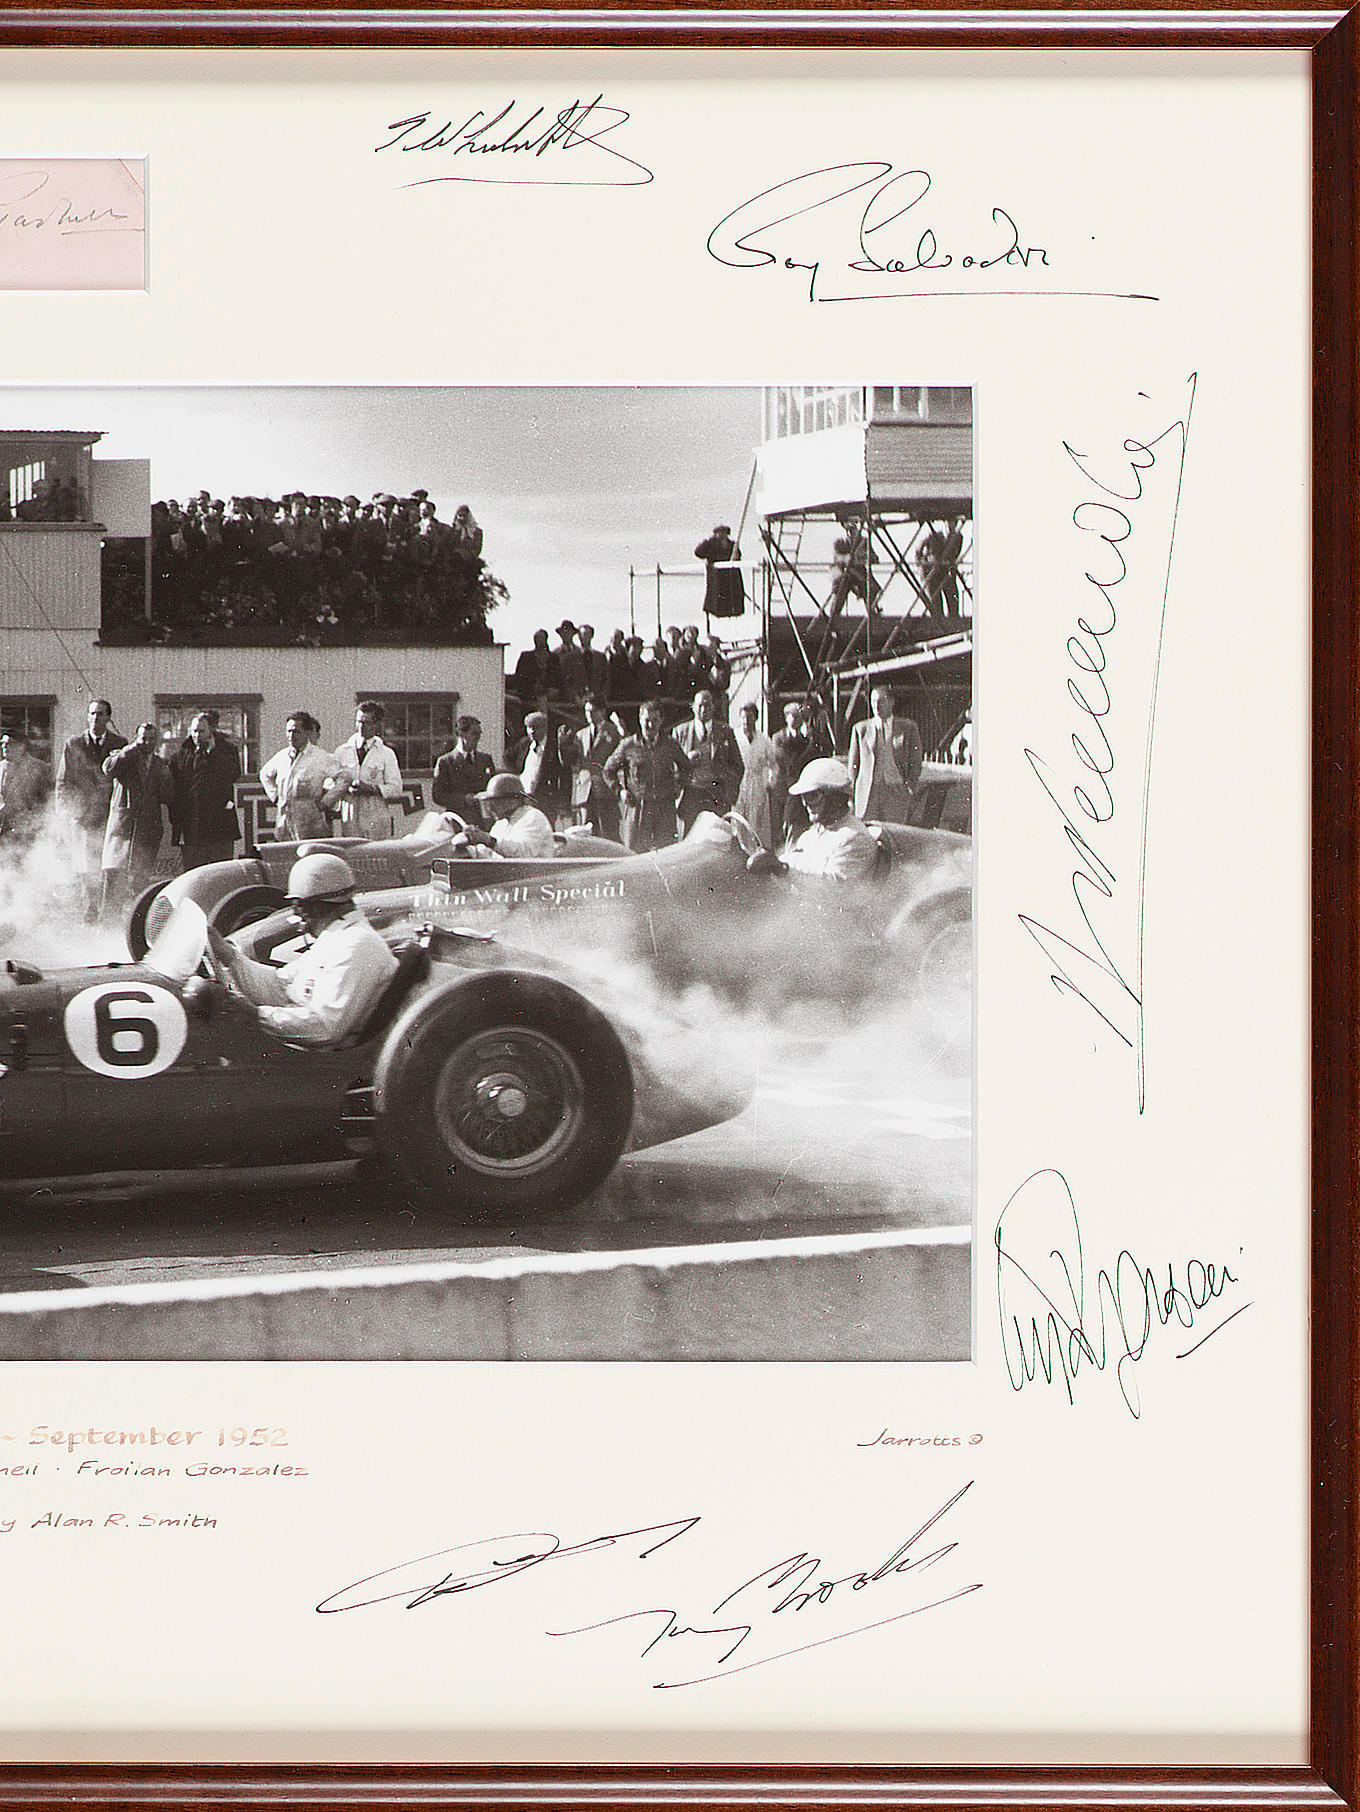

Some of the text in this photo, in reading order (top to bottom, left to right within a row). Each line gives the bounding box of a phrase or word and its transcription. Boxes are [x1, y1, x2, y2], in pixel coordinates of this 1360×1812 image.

[409, 880, 626, 907] Thin Wall Special
[95, 991, 158, 1066] 6
[28, 1426, 202, 1453] September
[219, 1427, 288, 1447] 1952
[185, 1461, 310, 1478] Gonzalez
[31, 1511, 94, 1529] Alan
[104, 1513, 129, 1528] R.
[139, 1513, 217, 1529] Smith
